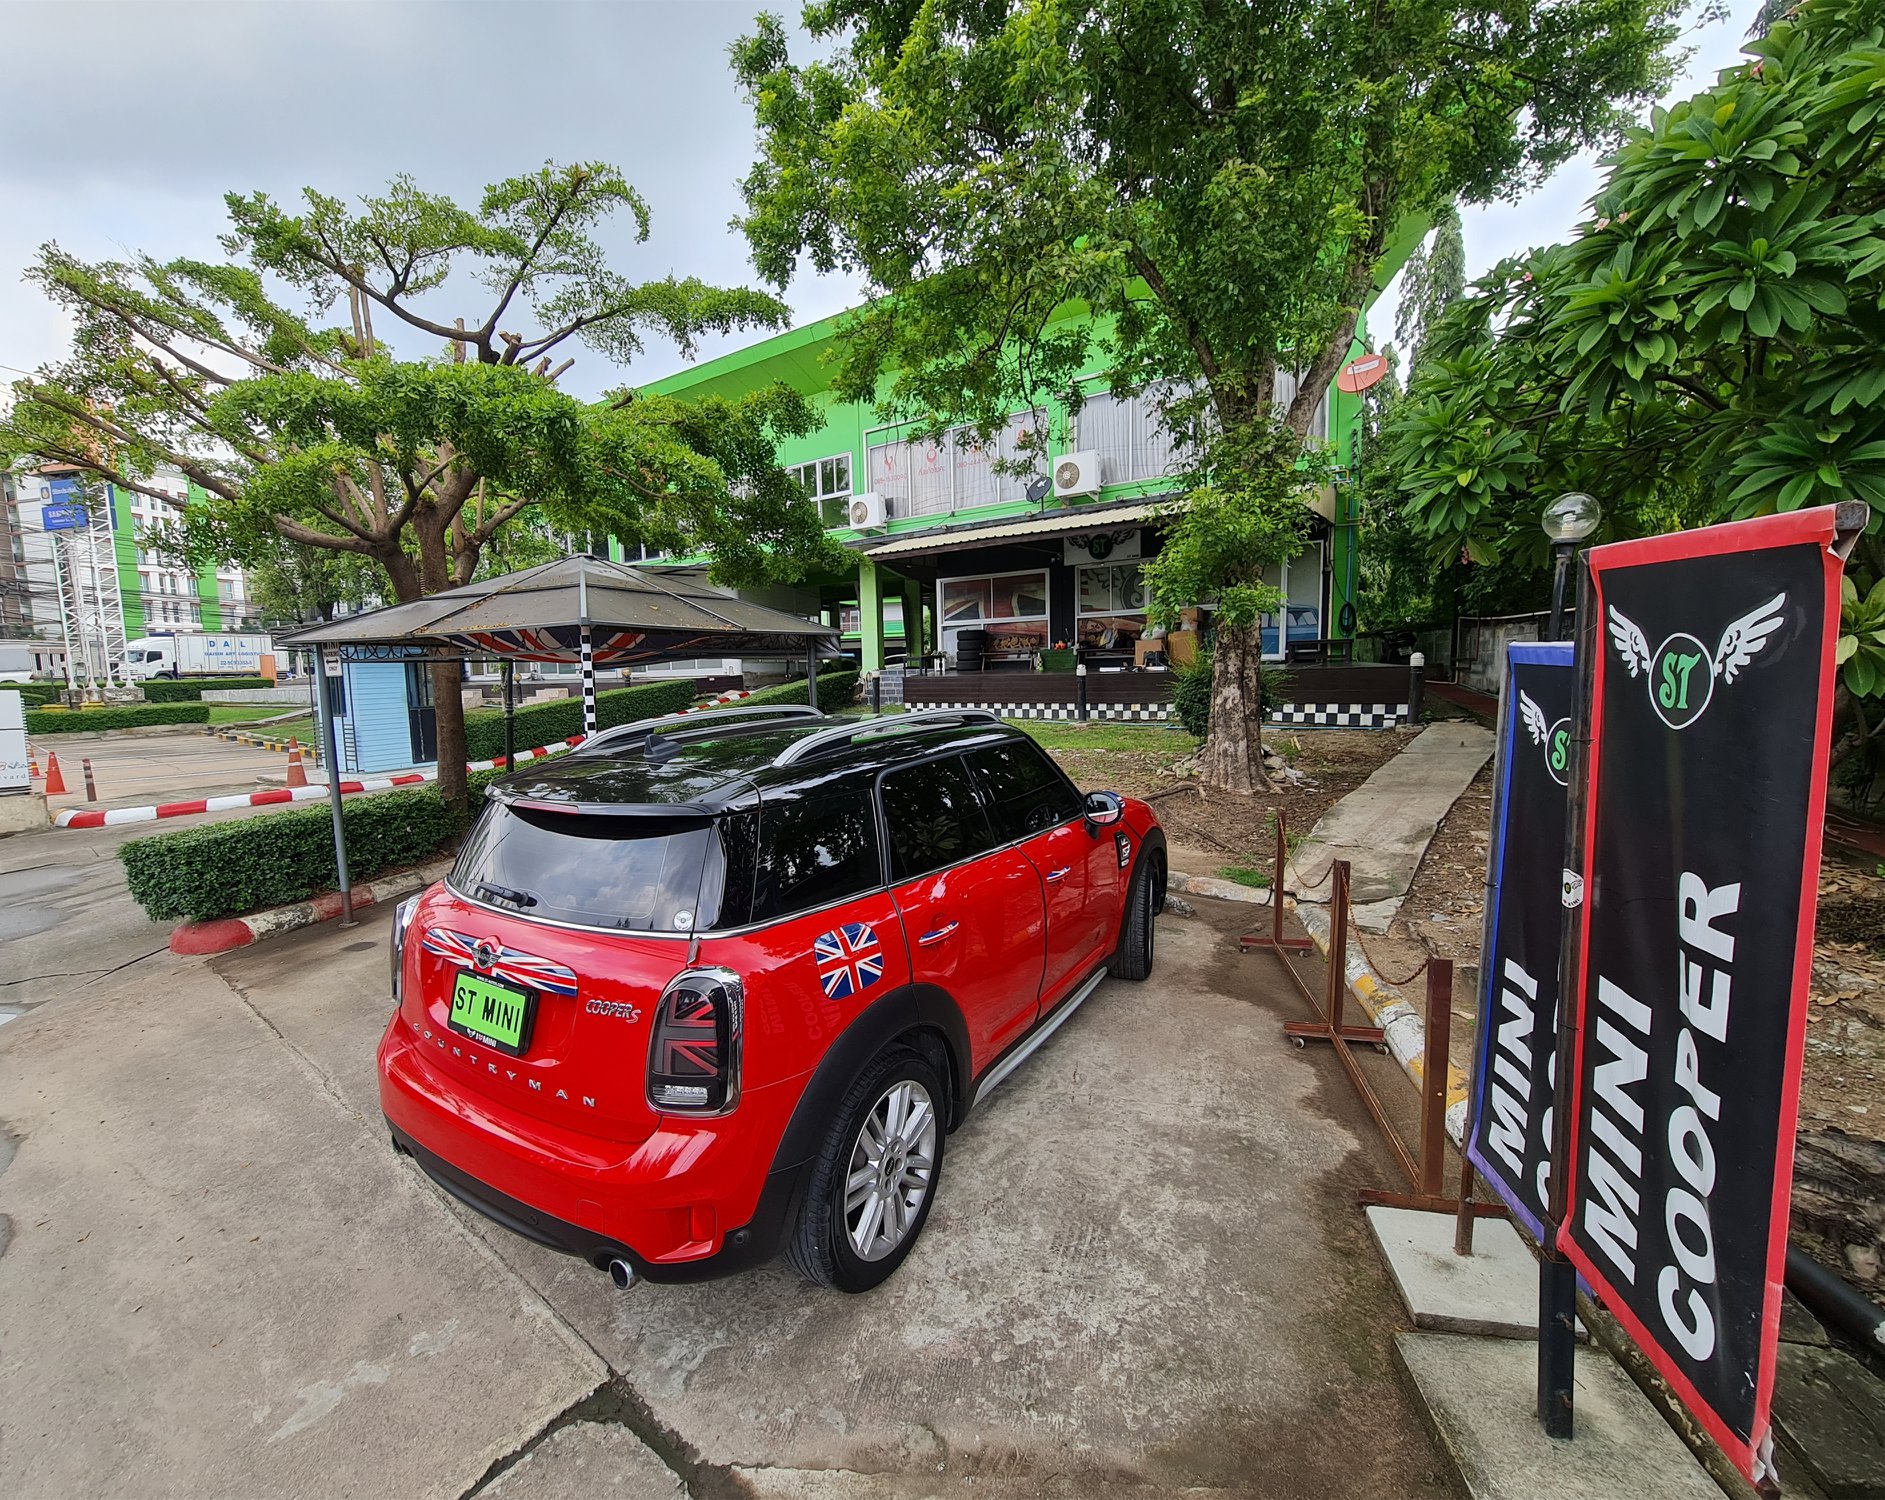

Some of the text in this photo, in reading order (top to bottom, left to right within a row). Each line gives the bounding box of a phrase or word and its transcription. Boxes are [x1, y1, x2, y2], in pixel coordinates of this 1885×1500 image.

[1092, 539, 1107, 553] ST
[1658, 650, 1701, 711] ST
[1551, 730, 1571, 772] S
[455, 986, 520, 1034] ST MINI
[413, 1022, 596, 1108] COUNTRYMAN
[1488, 957, 1538, 1179] MINI
[1583, 974, 1652, 1286] MINI
[1656, 870, 1741, 1363] COOPER
